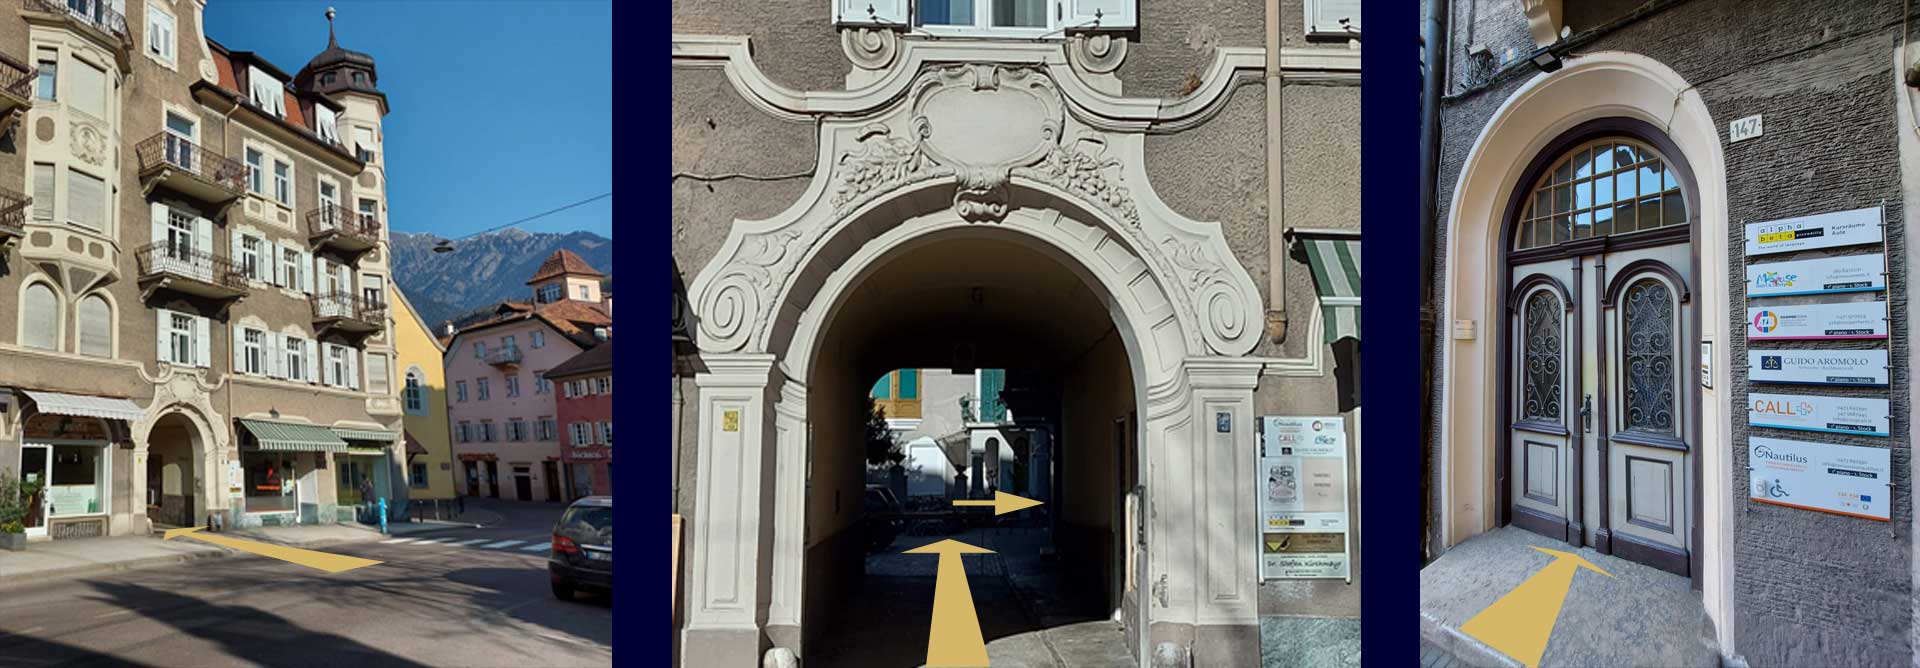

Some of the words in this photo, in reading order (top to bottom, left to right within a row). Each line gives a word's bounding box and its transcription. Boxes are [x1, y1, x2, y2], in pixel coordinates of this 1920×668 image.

[1734, 118, 1758, 138] 147
[1760, 223, 1802, 233] alpha
[1760, 233, 1793, 242] beta
[1783, 357, 1815, 365] GUIDO
[1817, 358, 1868, 366] AROMOLO
[1755, 400, 1796, 415] CALL
[1765, 451, 1808, 463] Nautilus
